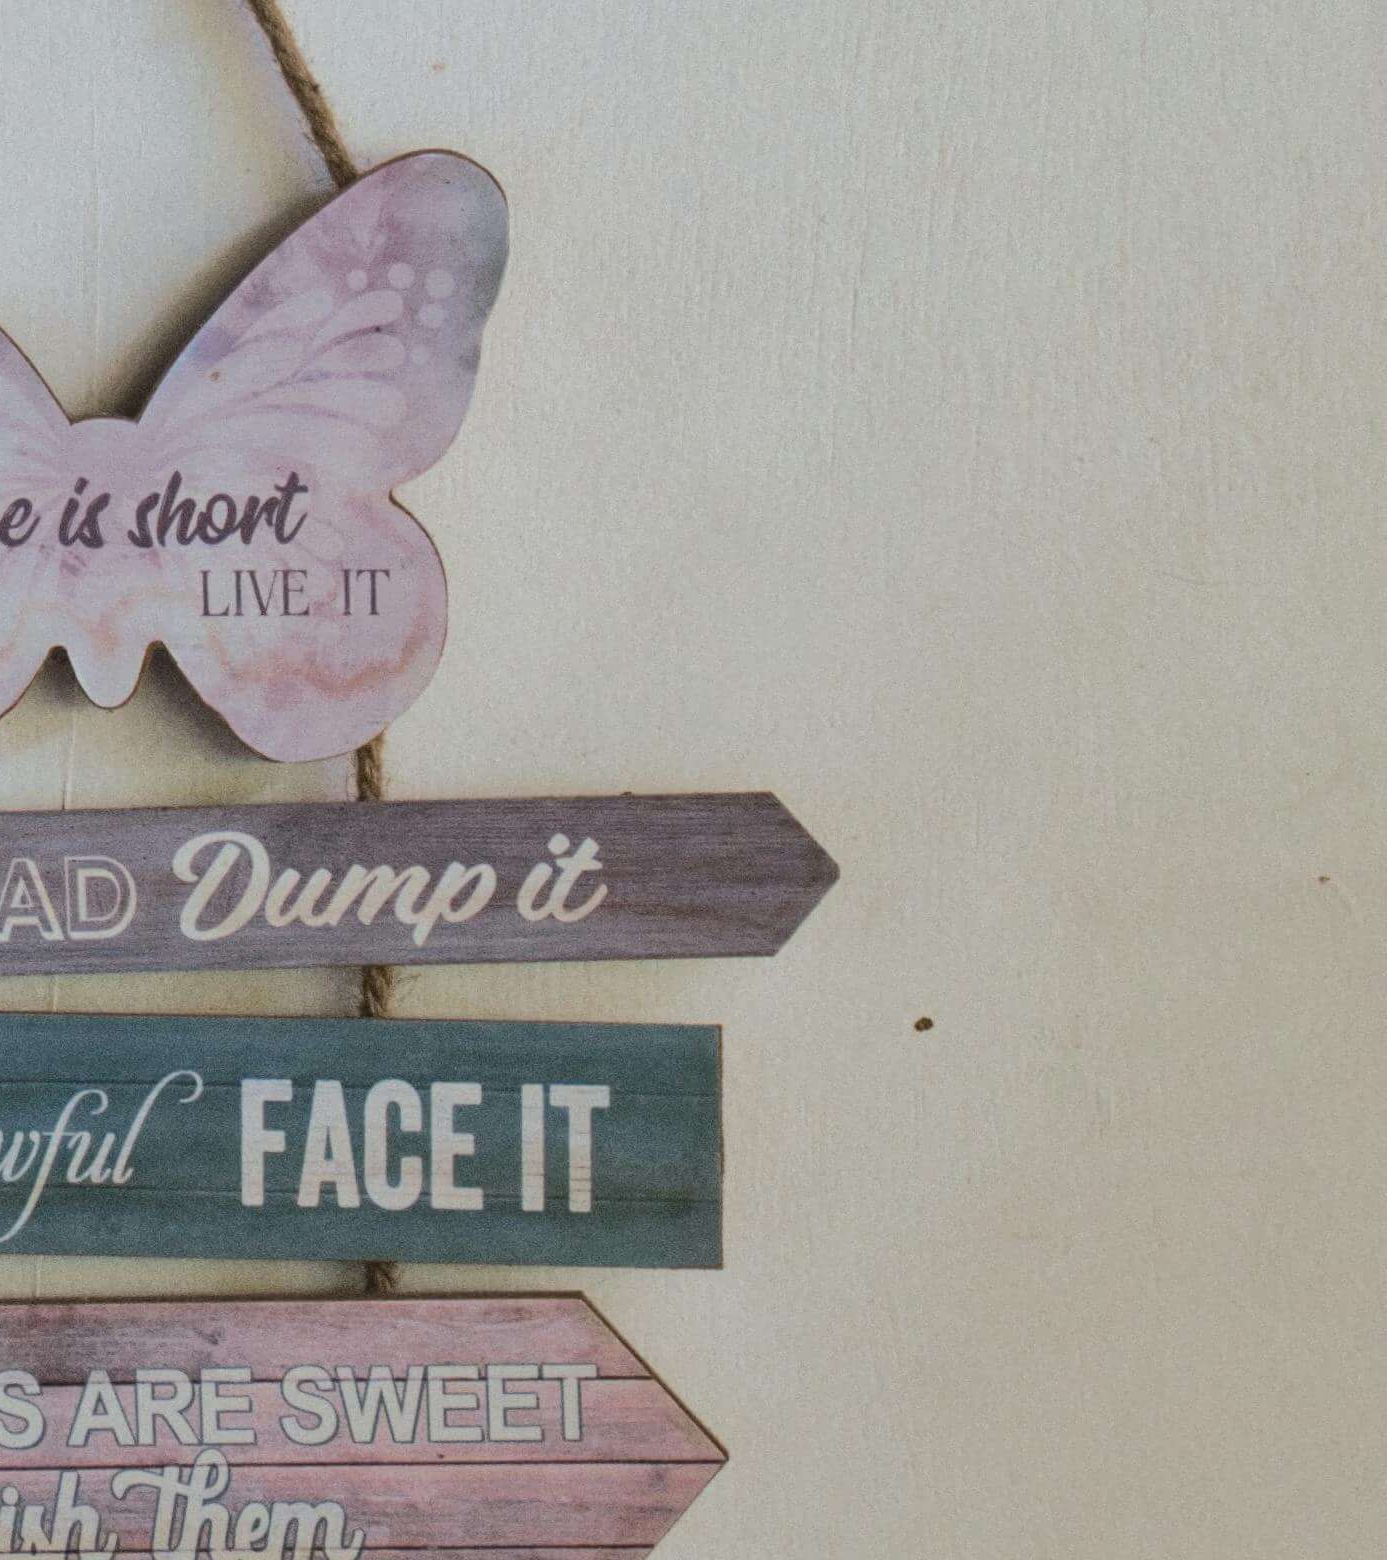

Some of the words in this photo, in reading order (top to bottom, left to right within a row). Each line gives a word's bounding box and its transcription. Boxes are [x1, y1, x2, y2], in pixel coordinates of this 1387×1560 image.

[57, 476, 105, 548] is
[127, 469, 311, 549] short
[199, 568, 312, 619] LIVE
[341, 567, 391, 616] IT
[171, 830, 496, 942] Dump
[512, 830, 609, 922] it
[239, 1079, 485, 1212] FACE
[519, 1082, 613, 1212] IT
[68, 1366, 257, 1449] ARE
[278, 1360, 599, 1446] SWEET
